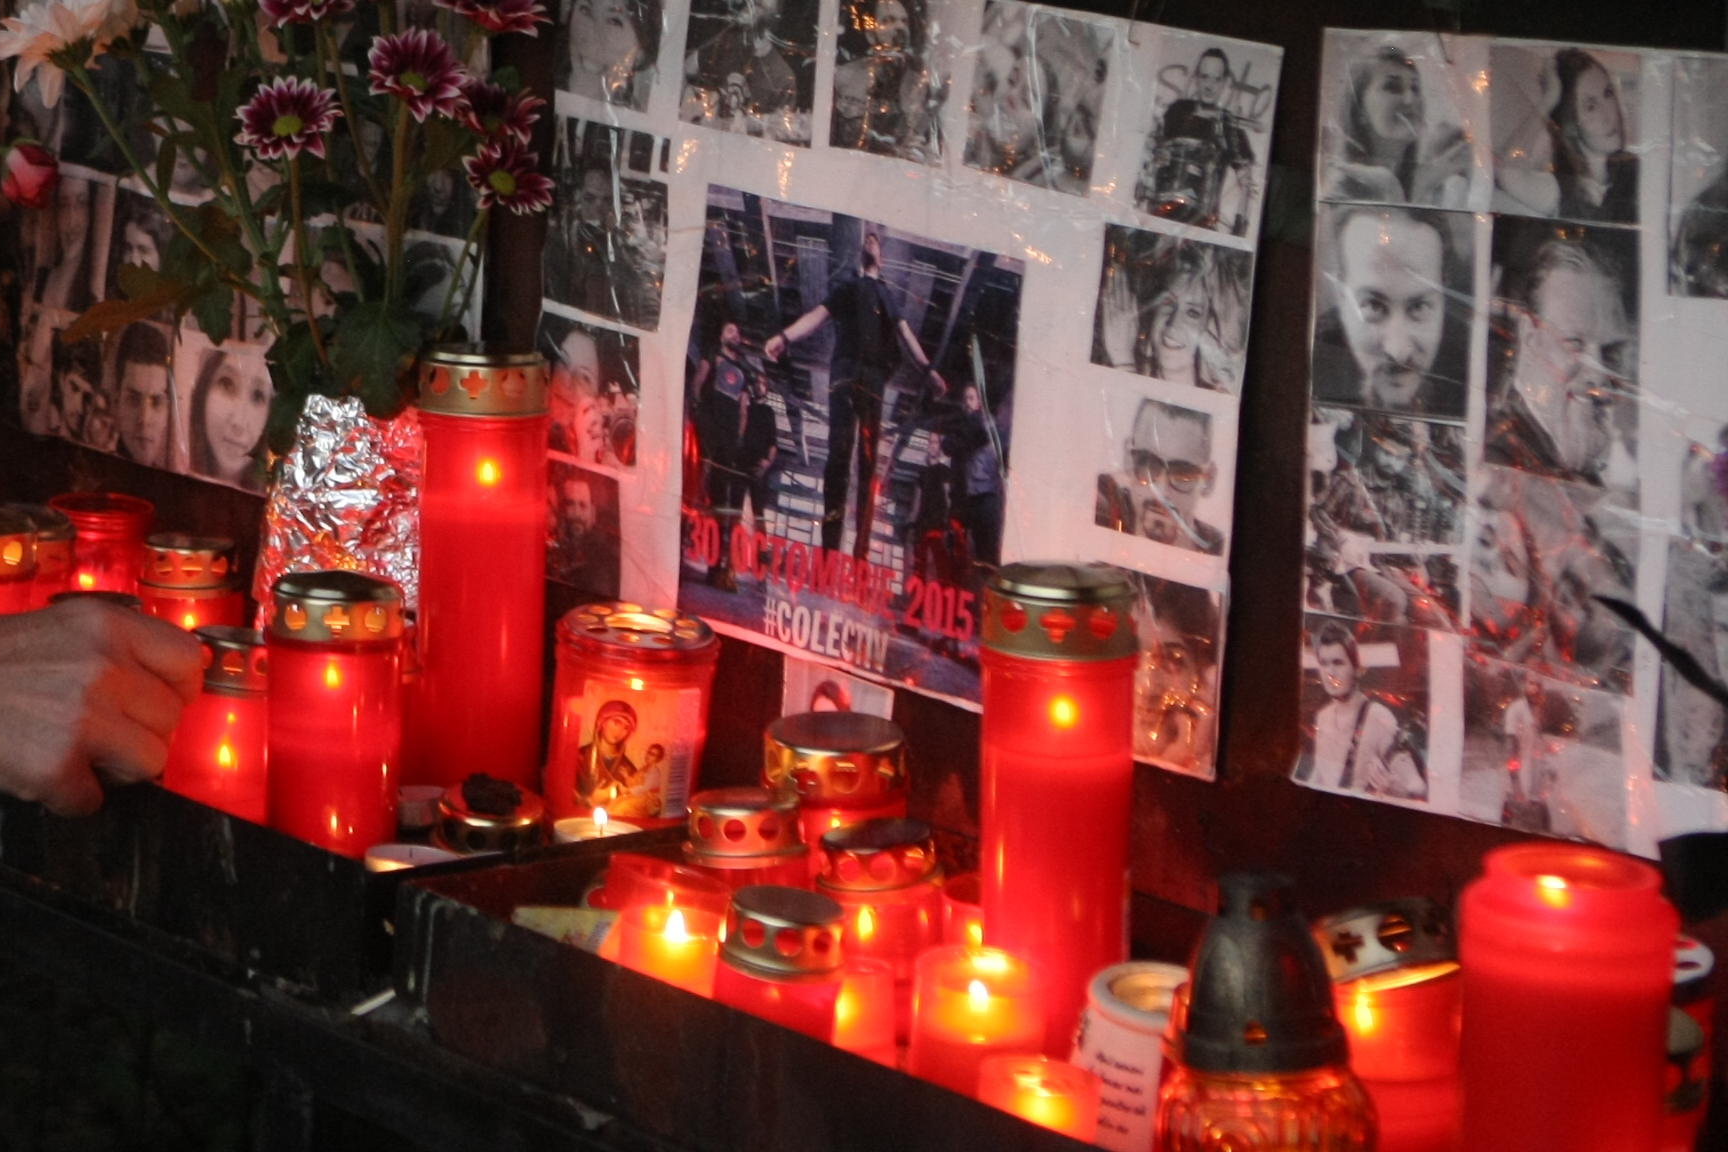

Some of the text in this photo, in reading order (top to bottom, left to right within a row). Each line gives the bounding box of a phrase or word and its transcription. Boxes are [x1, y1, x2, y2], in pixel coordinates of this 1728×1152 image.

[685, 512, 976, 642] 30 OCTOMBRIE 2015
[763, 599, 890, 673] #COLECTIV
